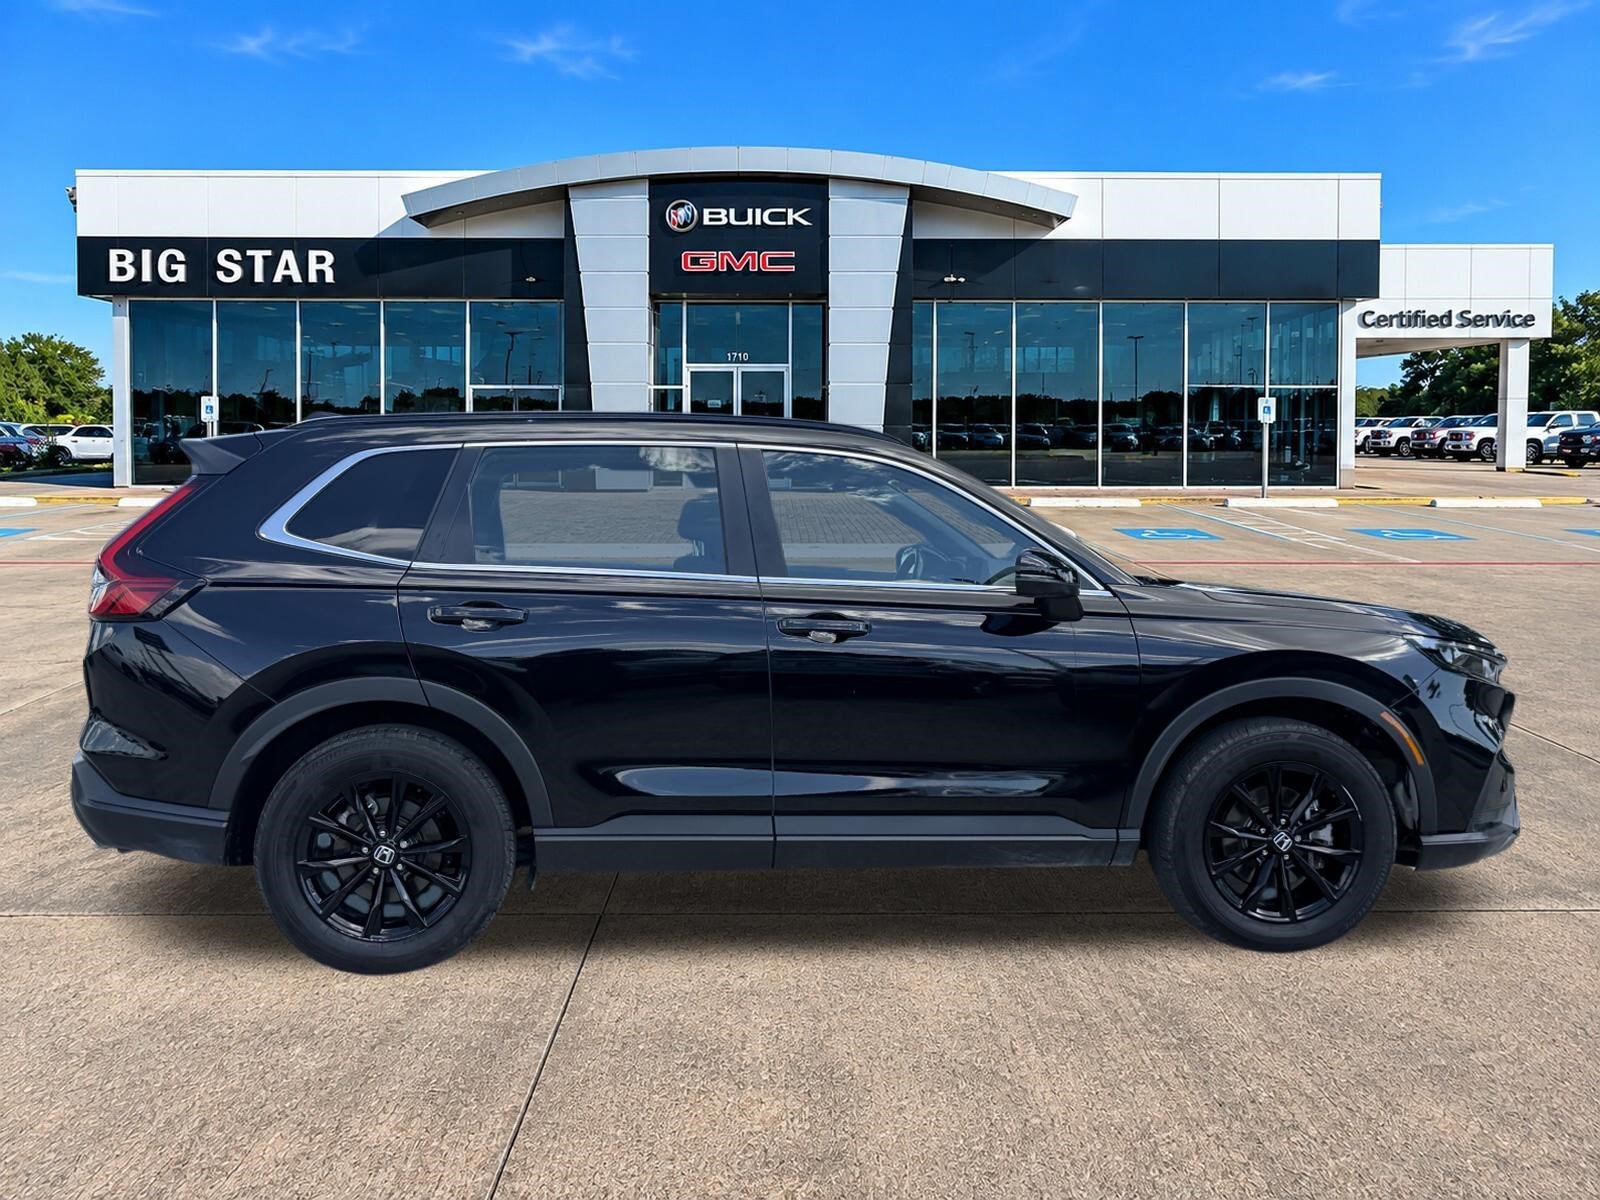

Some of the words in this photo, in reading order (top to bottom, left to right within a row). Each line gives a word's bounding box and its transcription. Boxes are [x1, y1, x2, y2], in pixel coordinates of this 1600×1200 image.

[702, 207, 813, 226] BUICK
[108, 248, 187, 284] BIG
[215, 248, 336, 284] STAR
[681, 250, 796, 272] GMC
[1358, 309, 1453, 329] Certified
[1455, 309, 1536, 329] Service
[726, 352, 749, 361] 1710
